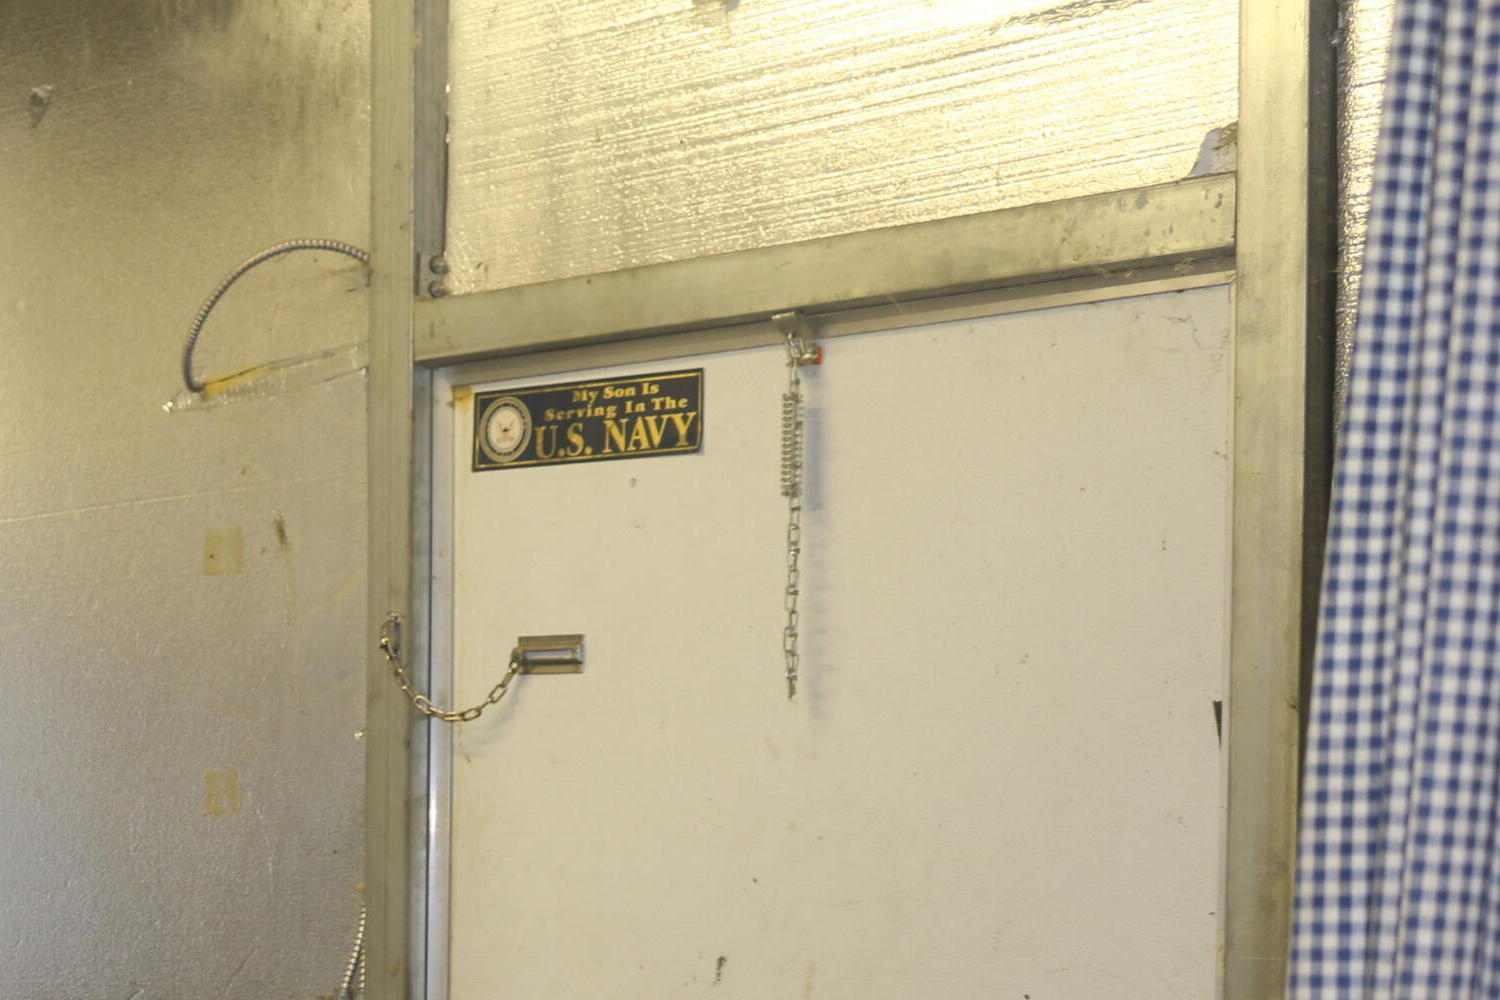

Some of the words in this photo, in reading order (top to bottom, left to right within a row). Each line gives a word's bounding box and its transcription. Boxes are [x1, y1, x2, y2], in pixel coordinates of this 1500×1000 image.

[573, 389, 600, 405] My
[603, 385, 636, 399] Son
[642, 382, 660, 395] Is
[544, 403, 617, 421] Serving
[625, 401, 645, 413] In
[651, 396, 688, 411] The
[534, 422, 593, 459] U.S.
[602, 411, 697, 454] NAVY
